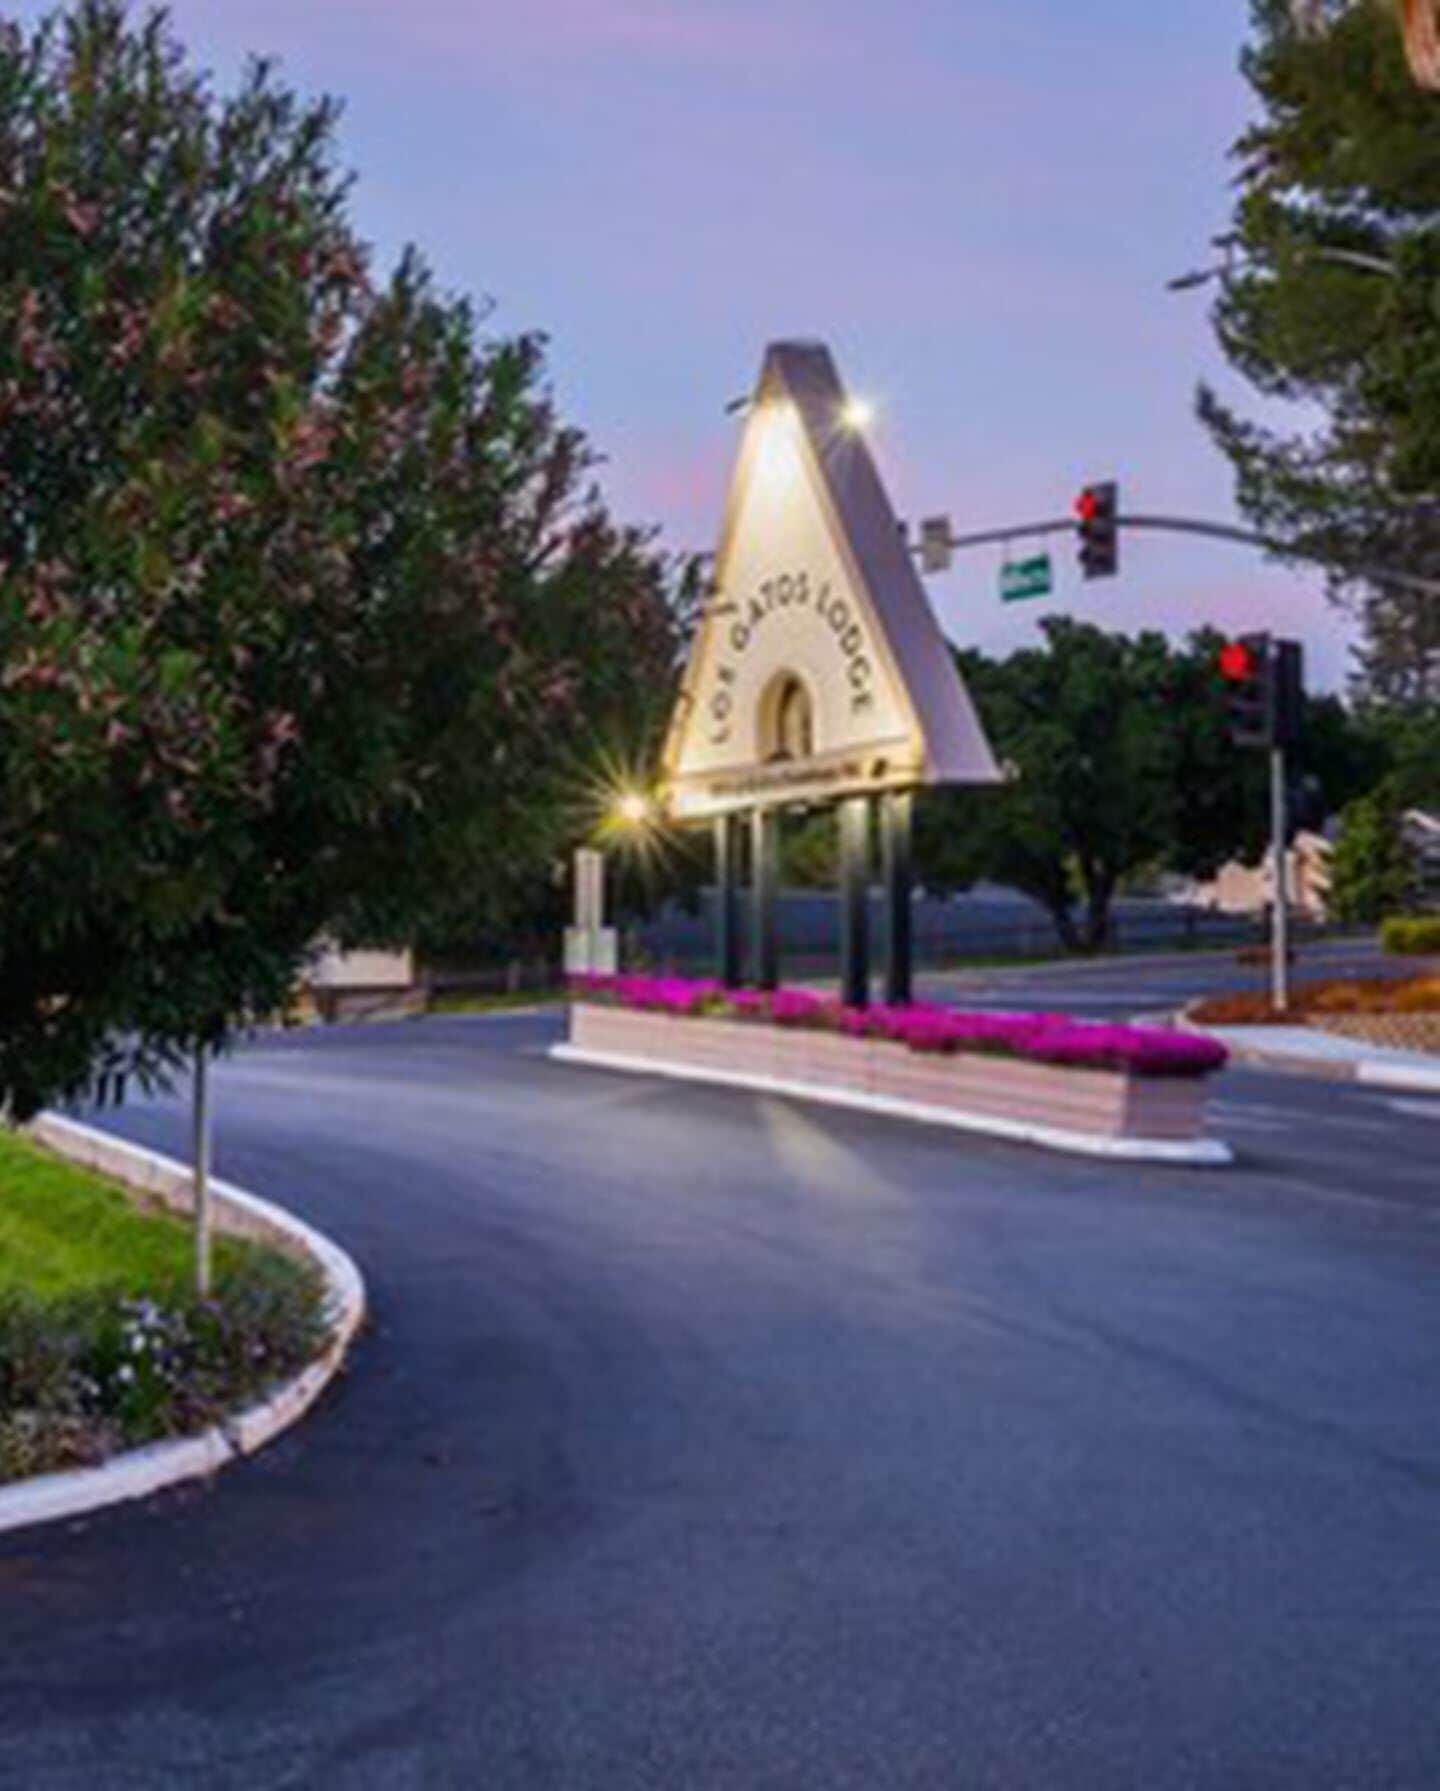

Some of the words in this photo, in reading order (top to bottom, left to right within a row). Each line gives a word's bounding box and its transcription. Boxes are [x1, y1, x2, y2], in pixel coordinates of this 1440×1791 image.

[710, 667, 735, 743] LOS
[730, 572, 809, 651] GATOS
[816, 582, 873, 713] LODGE
